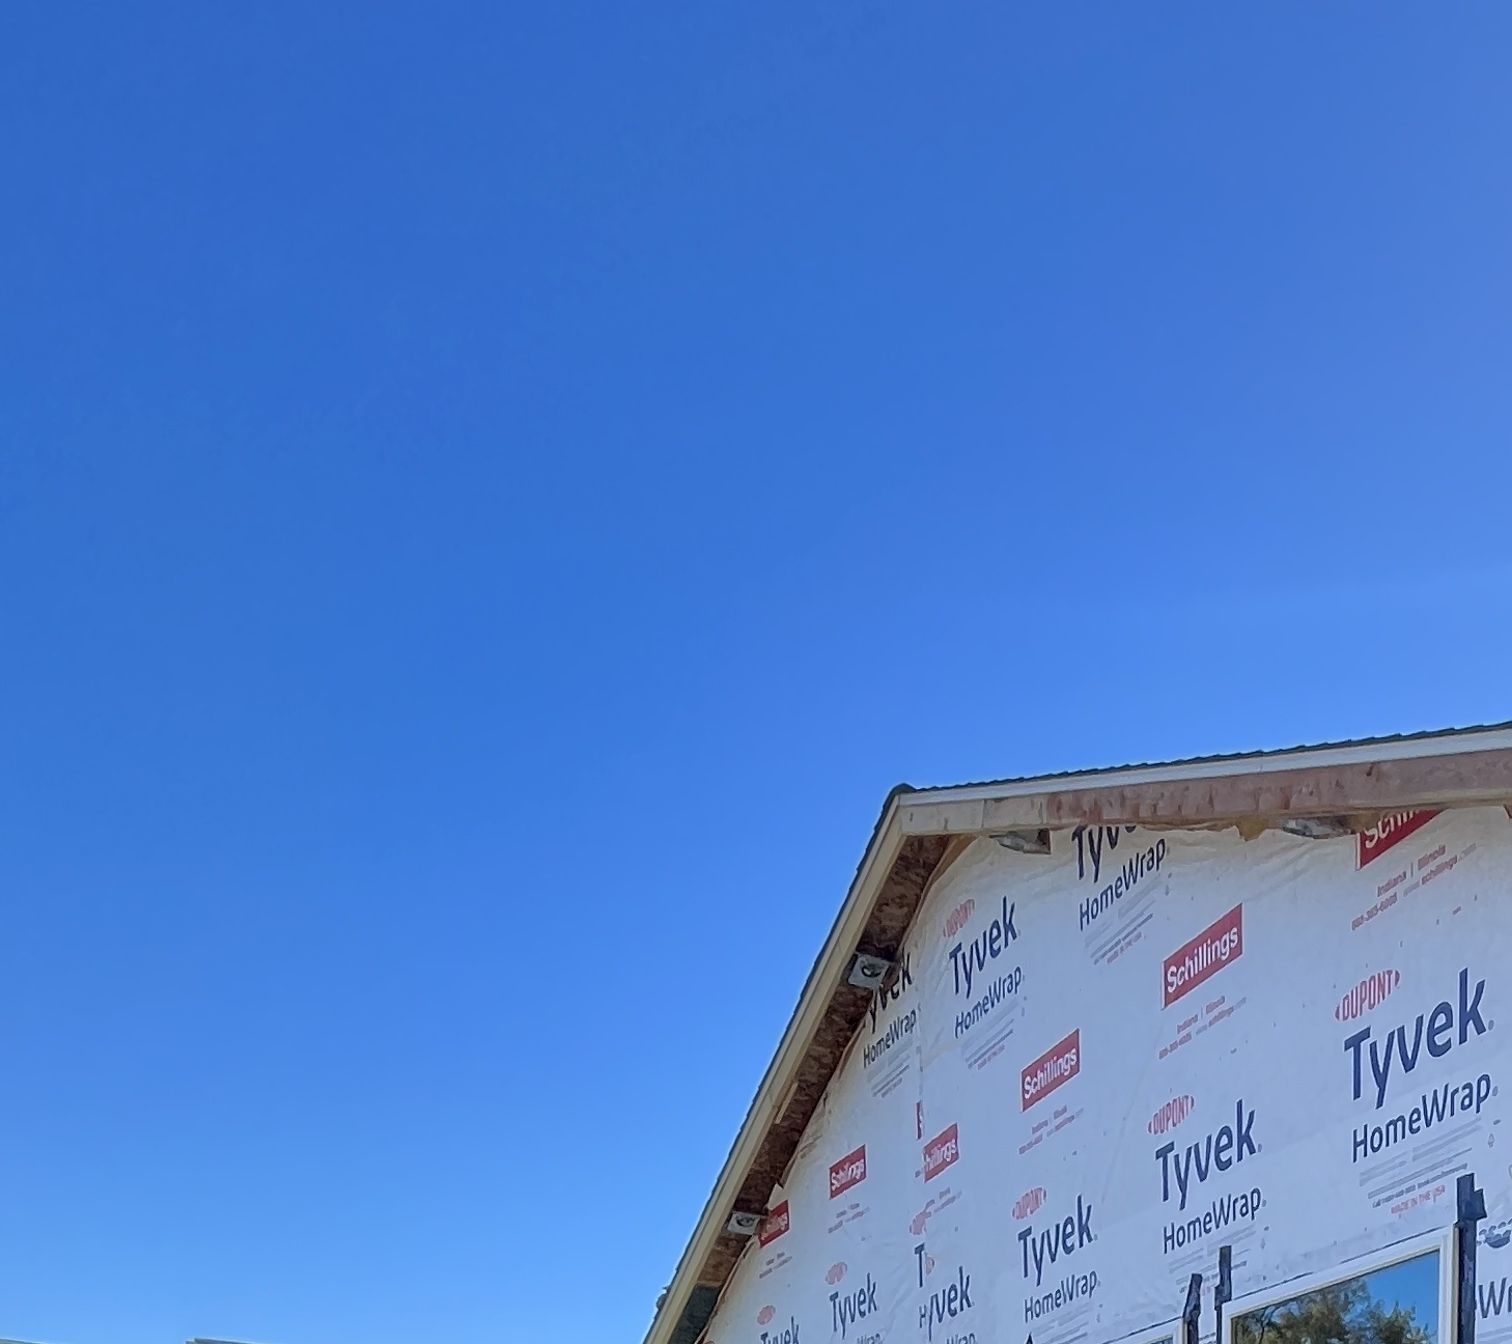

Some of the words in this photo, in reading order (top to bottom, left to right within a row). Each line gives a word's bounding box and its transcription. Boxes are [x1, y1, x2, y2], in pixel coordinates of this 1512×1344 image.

[1079, 838, 1166, 931] HomeWrap
[949, 895, 1018, 999] Tyvek
[1167, 927, 1238, 993] Schillings
[955, 966, 1022, 1038] HomeWrap
[1342, 969, 1394, 1021] DUPONT
[863, 1007, 917, 1068] HomeWrap
[1344, 967, 1487, 1110] Tyvek
[1023, 1048, 1077, 1099] Schillings
[1153, 1095, 1190, 1135] DUPONT
[1353, 1073, 1491, 1163] HomeWrap
[1155, 1098, 1257, 1211] Tyvek
[1018, 1192, 1093, 1287] Tyvek
[1164, 1187, 1262, 1254] HomeWrap
[829, 1272, 878, 1340] Tyvek
[1024, 1270, 1097, 1324] HomeWrap
